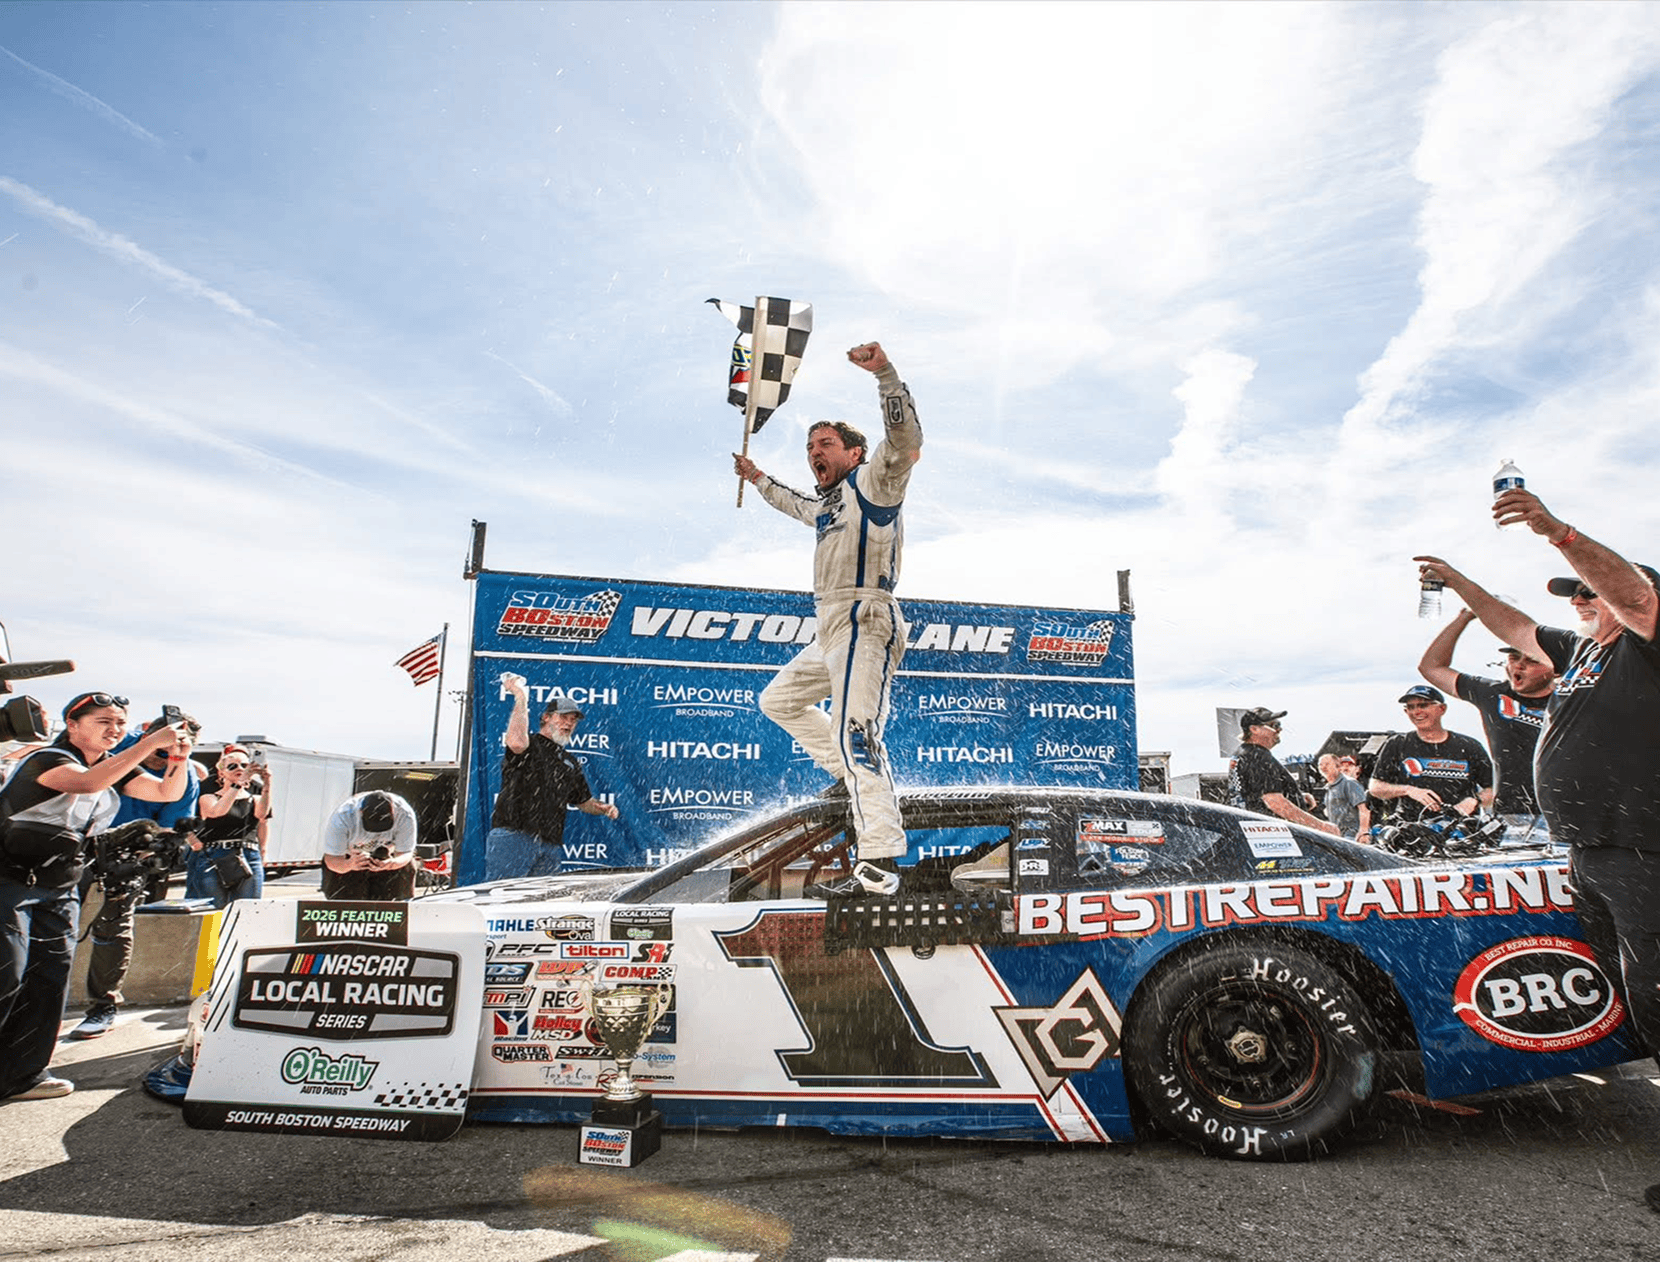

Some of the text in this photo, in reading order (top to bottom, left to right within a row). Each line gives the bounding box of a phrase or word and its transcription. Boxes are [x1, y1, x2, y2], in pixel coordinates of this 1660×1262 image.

[509, 591, 604, 612] SOUTH
[501, 607, 609, 628] BOSTON
[497, 623, 603, 639] SPEEDWAY
[1033, 622, 1101, 639] SOUTH
[1028, 637, 1108, 652] BOSTON
[1027, 650, 1104, 662] SPEEDWAY
[654, 684, 754, 704] EMPOWER
[919, 695, 1007, 711] EMPOWER
[1029, 703, 1117, 720] HITACHI
[675, 709, 735, 719] BROADBAND
[938, 716, 990, 725] BROADBAND
[647, 741, 1116, 763] HITACHI HITACHI EMPOWER
[1053, 765, 1101, 773] BROADBAND
[650, 788, 754, 805] EMPOWER
[673, 812, 732, 821] BROADBAND
[1016, 866, 1575, 939] BESTREPAIR.NE
[302, 909, 403, 923] 2026 FEATURE
[536, 917, 594, 930] Strange
[315, 921, 389, 938] WINNER
[569, 930, 594, 940] Oval
[498, 944, 557, 953] PFC
[566, 945, 625, 956] tilton
[1484, 938, 1574, 961] BEST REPAIR CO. INC.
[319, 954, 409, 977] NASCAR
[604, 966, 658, 978] COMP
[250, 980, 445, 1007] LOCAL RACING
[1251, 957, 1357, 1035] Hoosier
[1484, 967, 1600, 1018] BRC
[315, 1014, 368, 1029] SERIES
[532, 1015, 583, 1032] Holley
[530, 1030, 576, 1041] MSD
[1475, 1020, 1537, 1047] COMMERCIAL
[1543, 1031, 1596, 1048] INDUSTRIAL
[494, 1047, 547, 1056] QUARTER
[503, 1053, 550, 1061] MASTER
[283, 1049, 376, 1088] O'Reilly
[300, 1085, 348, 1096] AUTO PARTS
[225, 1110, 411, 1132] SOUTH BOSTON SPEEDWAY
[1159, 1074, 1268, 1155] Hoosier
[587, 1131, 622, 1141] SOUTH
[584, 1139, 625, 1149] BOSTON
[588, 1156, 622, 1165] WINNER
